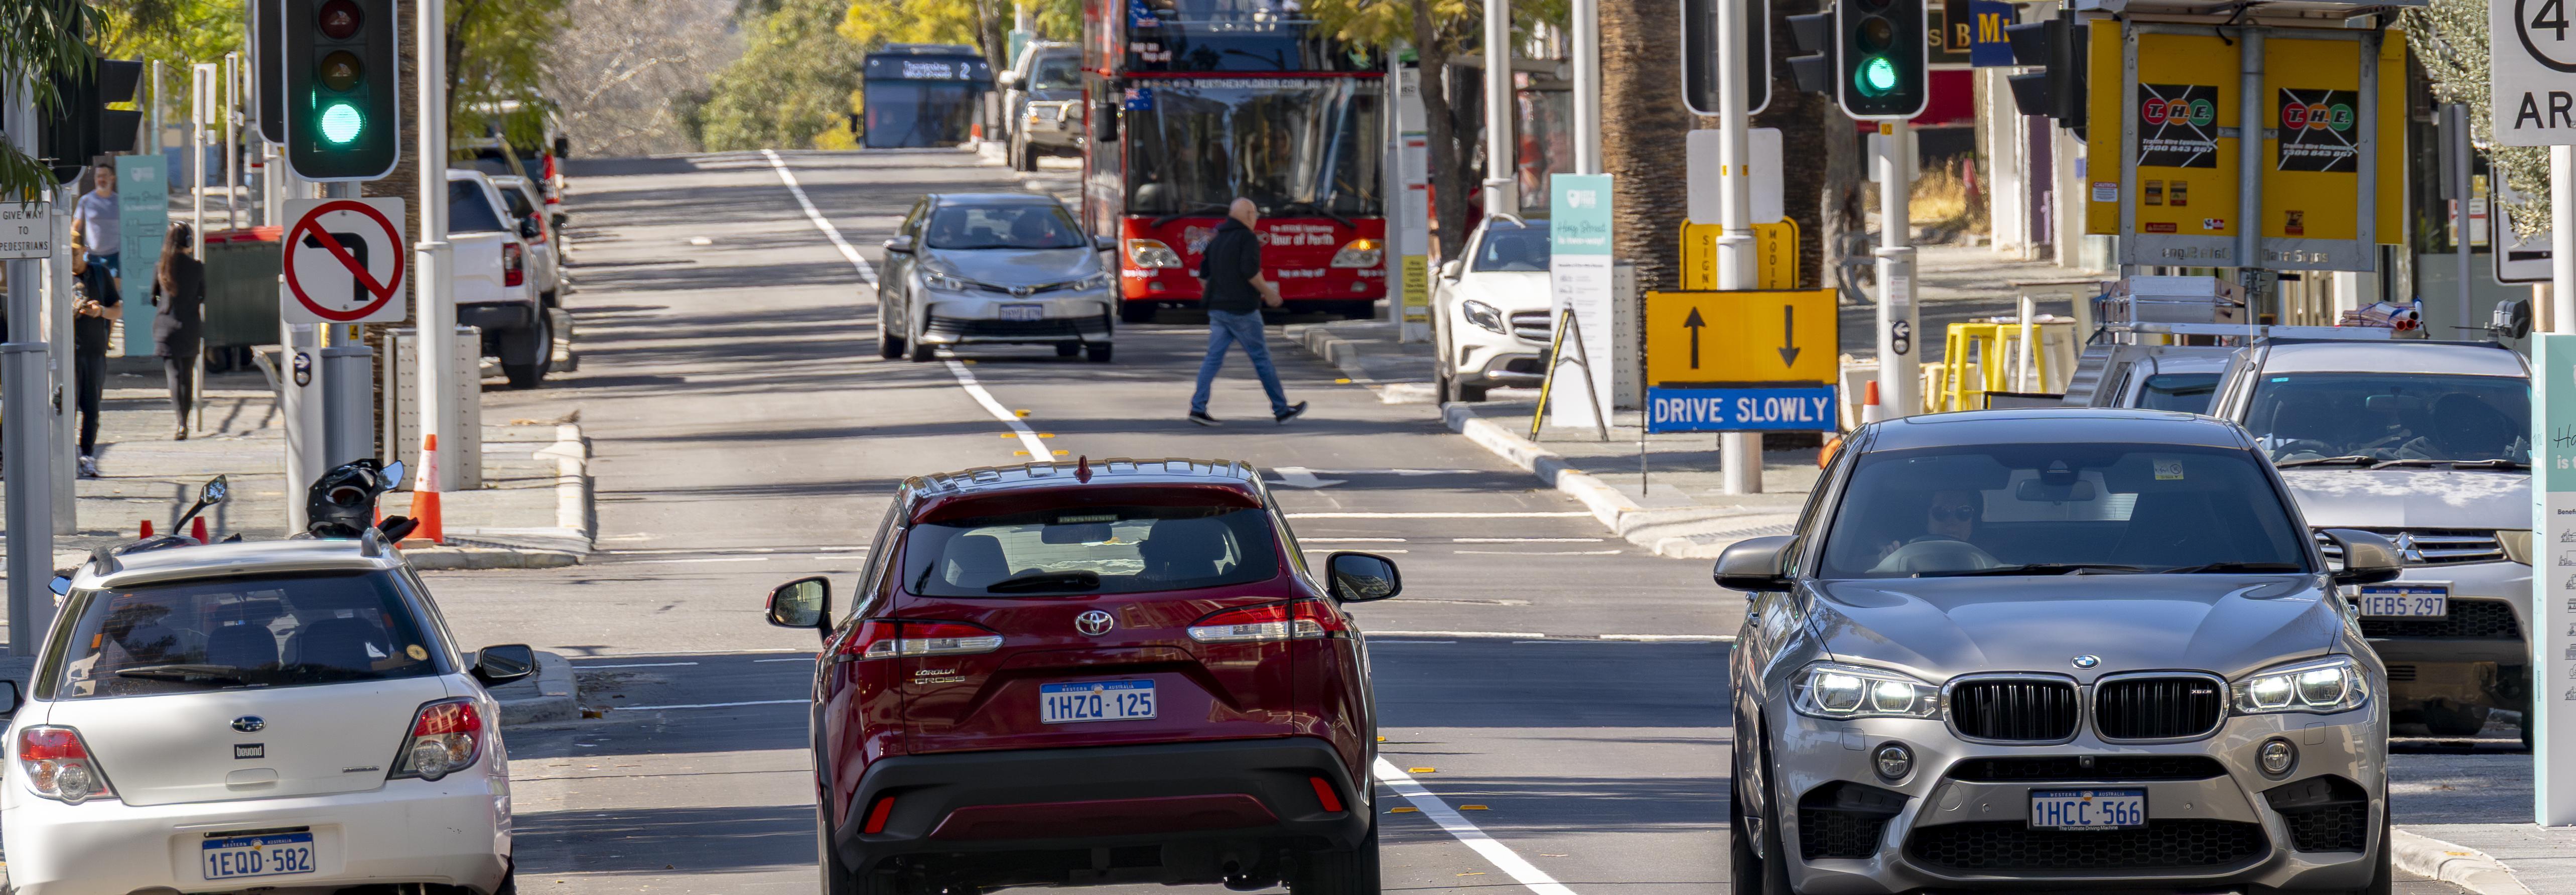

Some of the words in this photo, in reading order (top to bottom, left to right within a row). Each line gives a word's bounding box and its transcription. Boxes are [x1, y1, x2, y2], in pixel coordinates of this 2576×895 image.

[960, 62, 971, 79] 2
[3, 211, 22, 220] GIVE
[26, 211, 41, 219] WAY
[18, 226, 29, 234] TO
[0, 241, 48, 251] PEDESTRIANS
[1656, 398, 1723, 423] DRIVE
[1736, 397, 1828, 422] SLOWLY
[2557, 455, 2569, 469] is
[915, 676, 965, 684] CROSS
[237, 746, 262, 757] beyond
